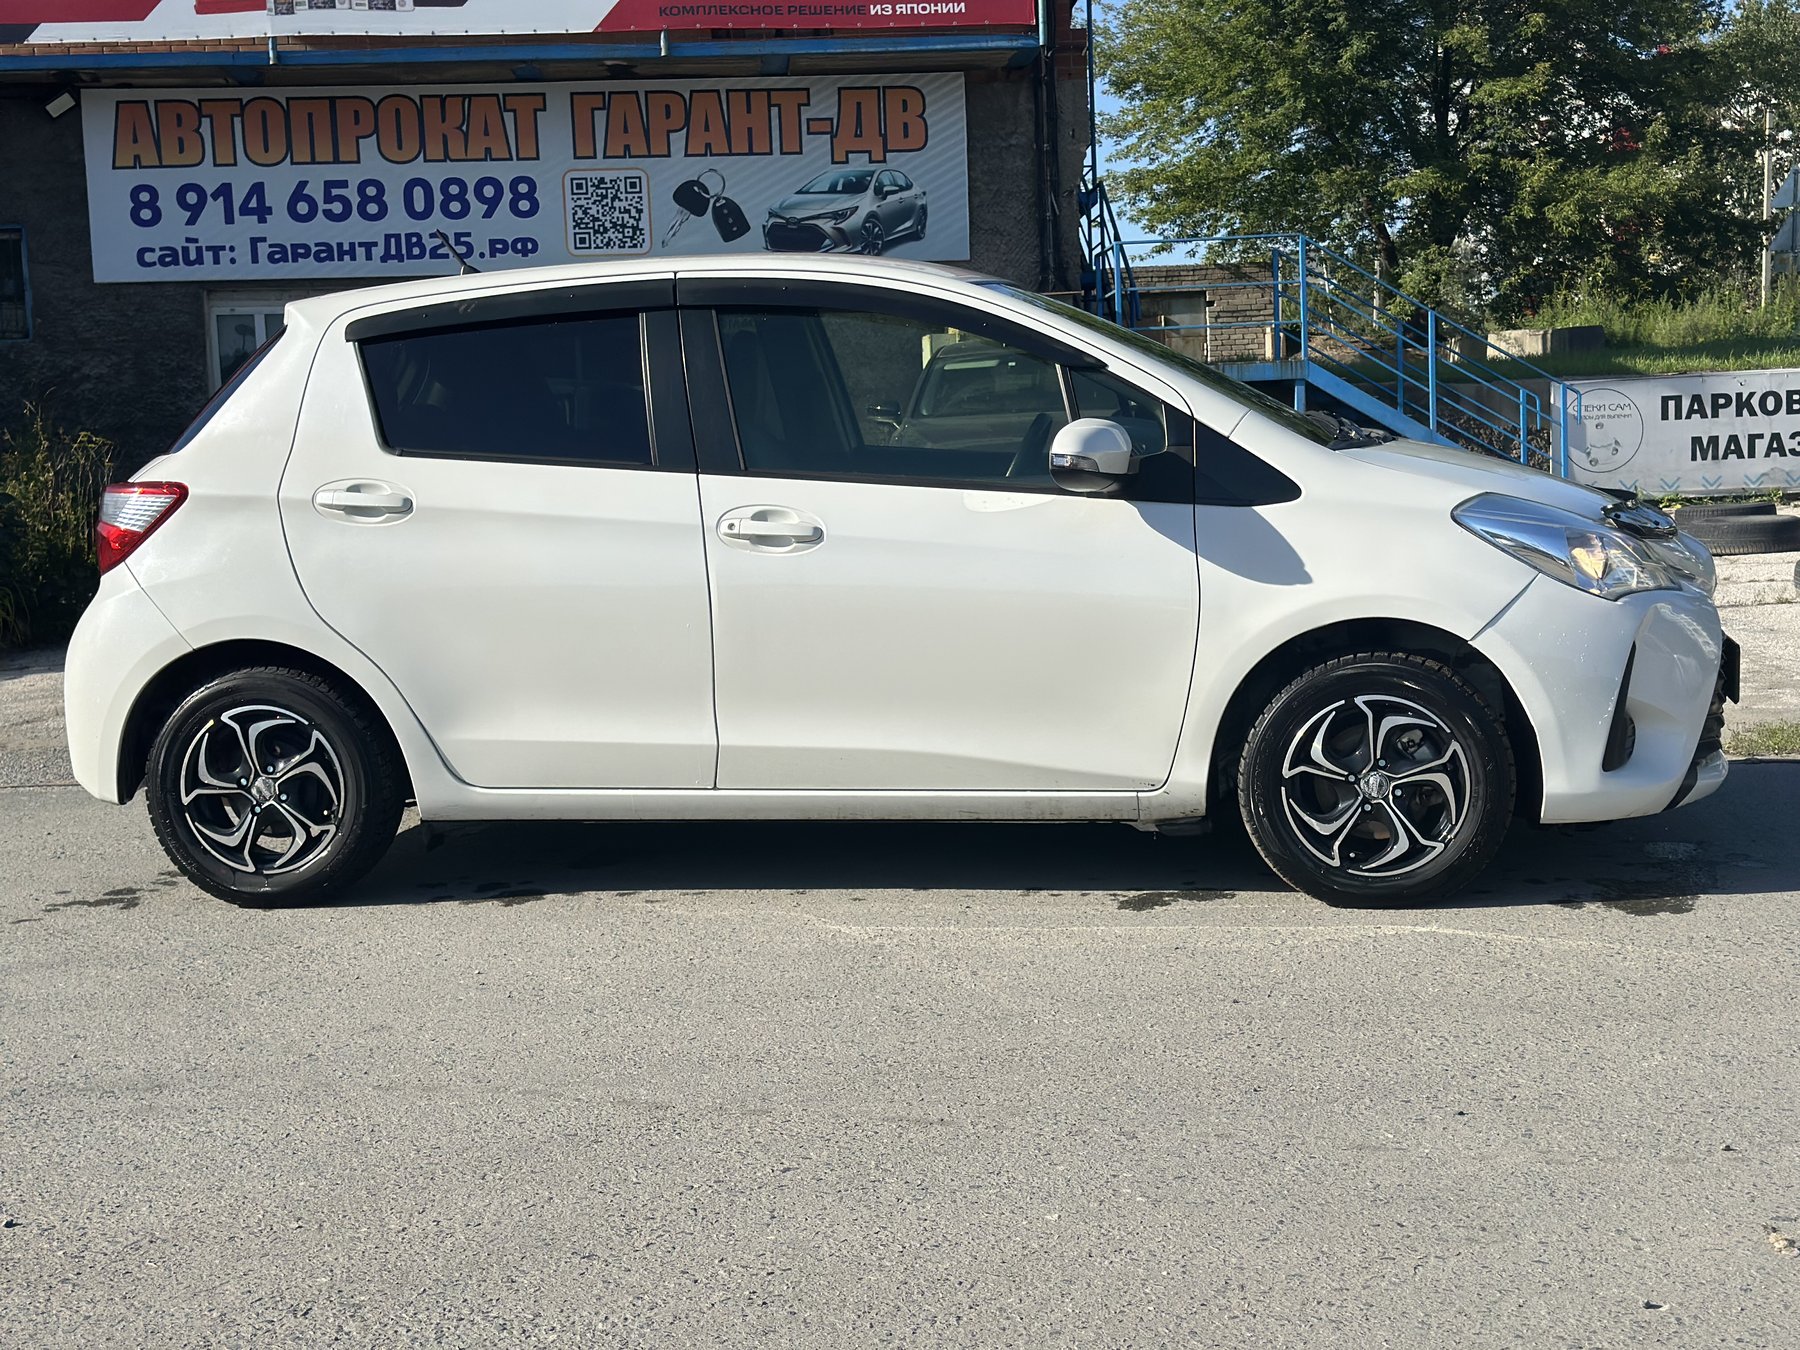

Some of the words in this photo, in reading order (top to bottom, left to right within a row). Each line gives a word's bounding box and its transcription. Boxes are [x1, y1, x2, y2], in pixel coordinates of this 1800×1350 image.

[659, 4, 784, 17] КОМПЛЕКСНОЕ
[787, 4, 866, 16] РЕШЕНИЕ
[869, 4, 893, 16] ИЗ
[895, 2, 966, 15] ЯПОНИИ
[112, 93, 547, 170] АВТОПРОКАТ
[569, 86, 929, 164] ГАРАНТ-ДВ
[129, 184, 163, 229] 8
[175, 181, 272, 226] 914
[286, 179, 388, 223] 658
[403, 176, 541, 220] 0898
[136, 237, 236, 268] сайт:
[250, 231, 539, 265] ГарантДВ25.рф
[1608, 403, 1632, 411] САМ
